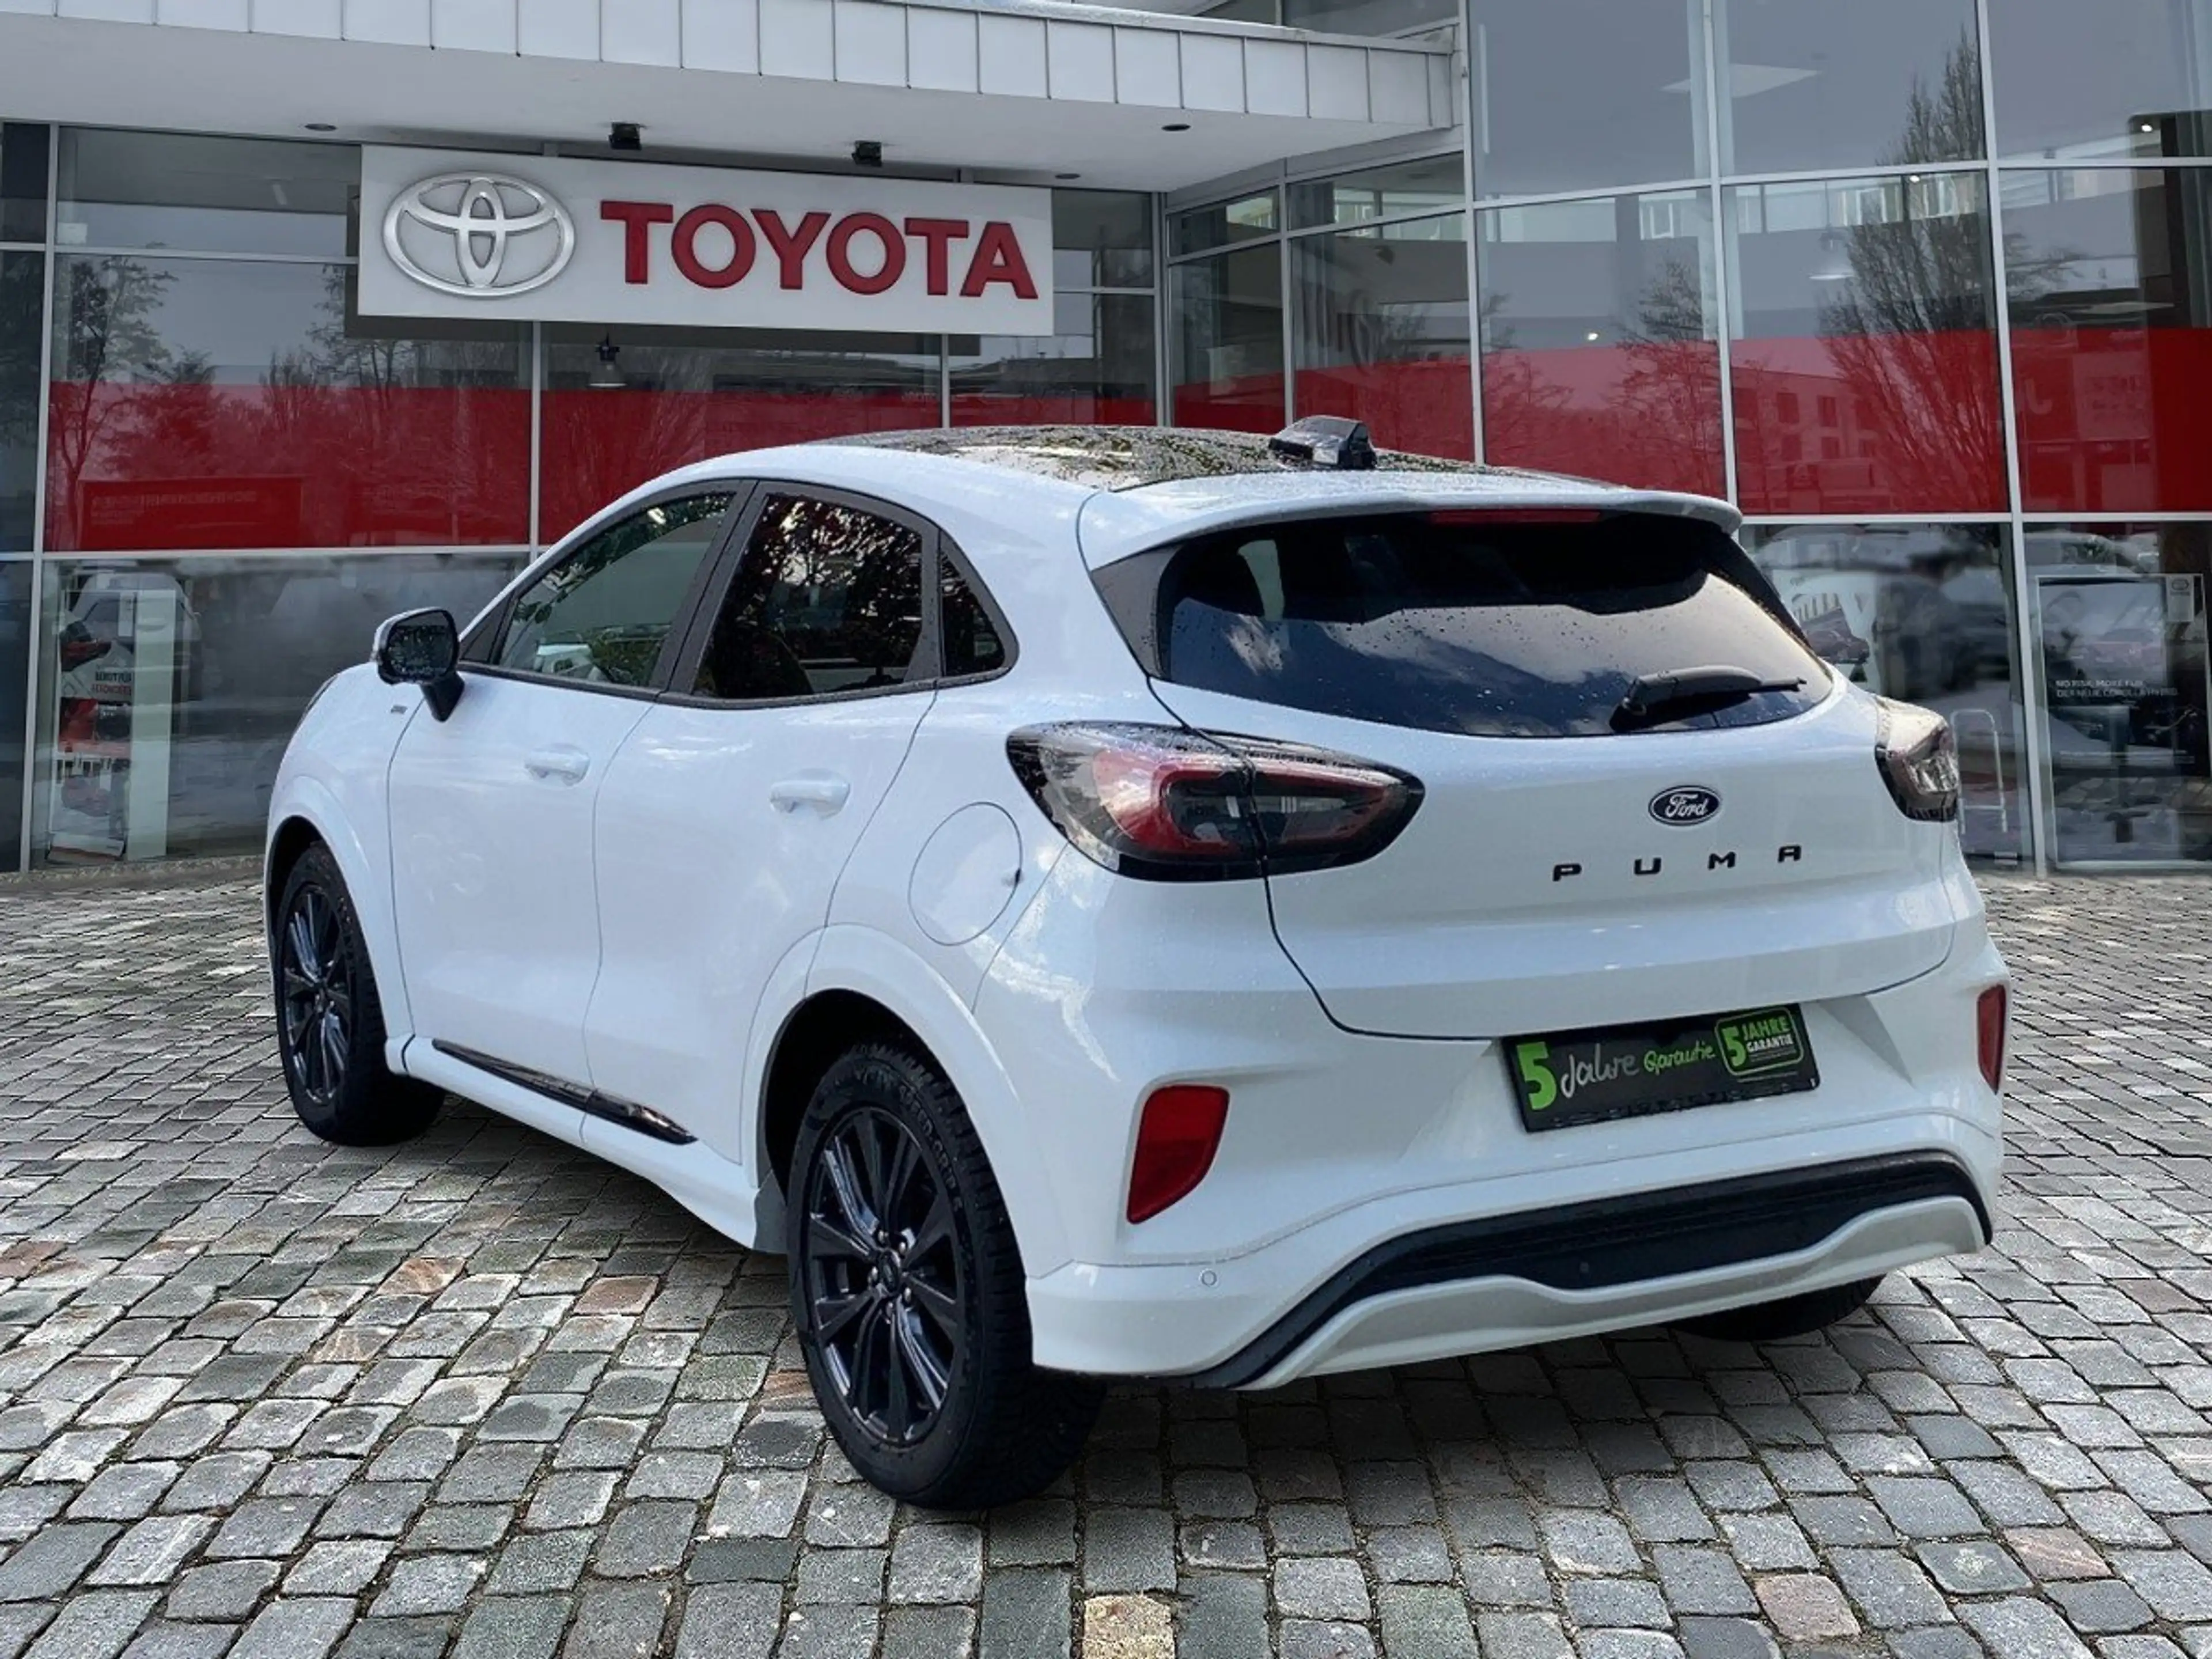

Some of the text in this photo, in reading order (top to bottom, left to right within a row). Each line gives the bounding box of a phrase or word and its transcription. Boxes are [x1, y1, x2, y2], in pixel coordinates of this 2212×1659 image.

[600, 199, 1039, 300] TOYOTA
[1665, 791, 1709, 817] Ford
[1552, 844, 1802, 882] PUMA
[1721, 1025, 1747, 1067] 5
[1742, 1016, 1791, 1041] JAHRE
[1745, 1033, 1794, 1053] GARANTIE
[1516, 1040, 1716, 1111] 5 Jahre Garantie
